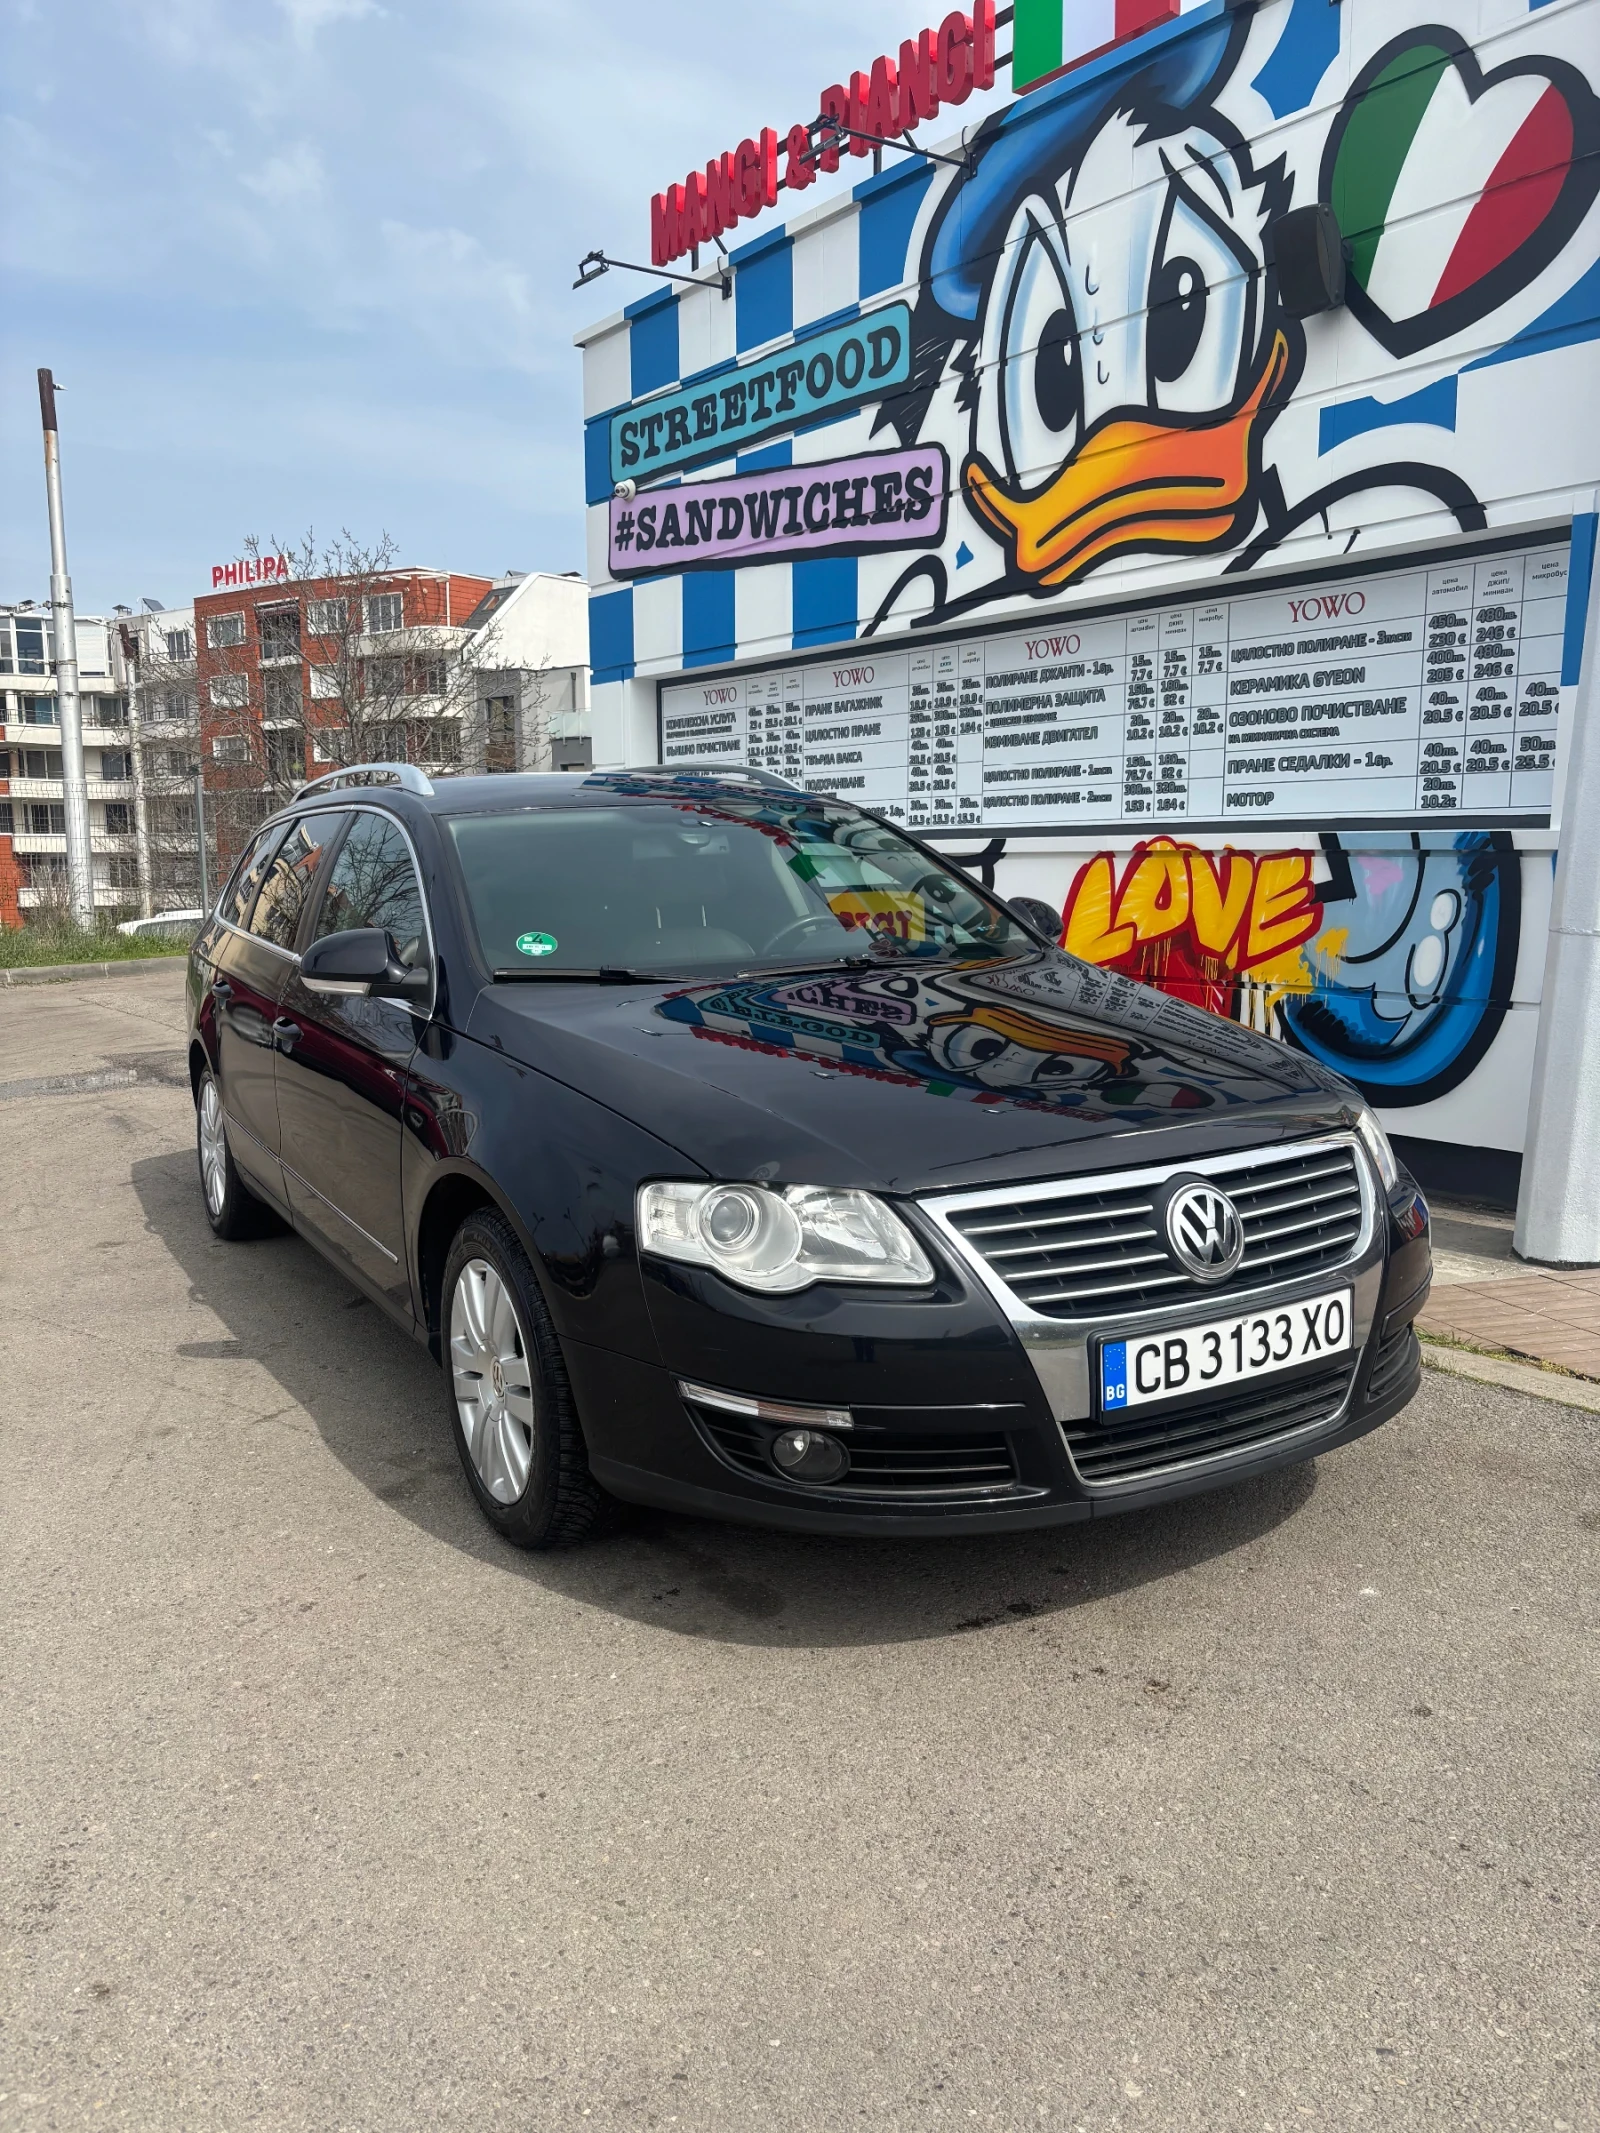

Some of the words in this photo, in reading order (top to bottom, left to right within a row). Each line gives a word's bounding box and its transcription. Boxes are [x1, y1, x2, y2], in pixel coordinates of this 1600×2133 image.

[651, 127, 777, 267] MANGI
[785, 123, 817, 191] &
[820, 0, 995, 174] PIANGI
[619, 325, 901, 467] STREETFOOD
[614, 465, 934, 552] #SANDWICHES
[212, 553, 289, 588] PHILIPA
[1542, 561, 1559, 570] цена
[1491, 569, 1507, 578] цена
[1532, 569, 1567, 581] микробус
[1442, 577, 1458, 585] цена
[1432, 585, 1468, 596] автомобил
[1483, 587, 1513, 597] миниван
[1288, 591, 1366, 623] YOWO
[1429, 614, 1467, 628] 450лв.
[1476, 607, 1517, 622] 480лв.
[1429, 634, 1455, 648] 230
[1458, 634, 1466, 644] €
[1476, 627, 1504, 642] 246
[1507, 627, 1515, 638] €
[1025, 634, 1081, 660] YOWO
[1231, 642, 1295, 663] ЦЯЛОСТНО
[1297, 633, 1367, 654] ПОЛИРАНЕ
[1474, 644, 1514, 659] 480лв.
[1427, 650, 1465, 664] 400лв.
[1163, 665, 1179, 677] 7.7
[1198, 661, 1214, 673] 7.7
[1474, 663, 1502, 678] 246
[1505, 663, 1513, 675] €
[833, 666, 874, 688] YOWO
[986, 670, 1038, 689] ПОЛИРАНЕ
[1040, 664, 1084, 683] ДЖАНТИ
[1131, 669, 1146, 681] 7.7
[1230, 673, 1309, 696] КЕРАМИКА
[1313, 667, 1365, 688] GYEON
[1427, 669, 1453, 683] 205
[1456, 669, 1464, 680] €
[703, 686, 737, 705] YOWO
[1163, 694, 1177, 706] 92
[1429, 691, 1459, 705] 40лв.
[1476, 687, 1507, 701] 40лв.
[805, 704, 833, 717] ПРАНЕ
[834, 696, 883, 712] БАГАЖНИК
[985, 695, 1053, 715] ПОЛИМЕРНА
[1055, 688, 1106, 709] ЗАЩИТА
[1127, 698, 1147, 710] 76.7
[1229, 707, 1298, 727] ОЗОНОВО
[1301, 697, 1407, 720] ПОЧИСТВАНЕ
[1470, 706, 1501, 720] 20.5
[1504, 706, 1512, 718] €
[1519, 701, 1552, 717] 20.5
[1423, 710, 1453, 724] 20.5
[1455, 710, 1464, 723] €
[852, 722, 881, 736] ПРАНЕ
[1127, 728, 1147, 740] 10.2
[1158, 726, 1181, 738] 10.2
[1193, 722, 1216, 735] 10.2
[1228, 734, 1240, 744] НА
[1241, 729, 1298, 743] КЛИМАТИЧНА
[1299, 726, 1340, 738] СИСТЕМА
[985, 732, 1040, 749] ИЗМИВАНЕ
[1042, 726, 1098, 745] ДВИГАТЕЛ
[1520, 736, 1556, 752] 50лв
[1424, 743, 1458, 757] 40лв.
[1470, 740, 1507, 754] 40лв.
[1228, 758, 1276, 775] ПРАНЕ
[1278, 753, 1350, 772] СЕДАЛКИ
[1365, 752, 1393, 769] 1бр.
[1420, 760, 1451, 774] 20.5
[1453, 760, 1462, 773] €
[1466, 758, 1499, 772] 20.5
[1501, 758, 1510, 771] €
[1515, 755, 1549, 770] 25.5
[984, 770, 1030, 783] ЦЯЛОСТНО
[1031, 765, 1081, 780] ПОЛИРАНЕ
[1125, 769, 1145, 781] 76.7
[1162, 767, 1175, 779] 92
[1423, 777, 1456, 791] 20лв.
[983, 795, 1029, 808] ЦЯЛОСТНО
[1031, 790, 1081, 804] ПОЛИРАНЕ
[1125, 800, 1144, 812] 153
[1157, 798, 1177, 811] 164
[1226, 792, 1274, 807] МОТОР
[1061, 836, 1324, 974] LOVE
[1135, 1338, 1190, 1394] CB
[1200, 1314, 1292, 1380] 3133
[1301, 1299, 1344, 1356] XO
[1106, 1383, 1125, 1400] BG
